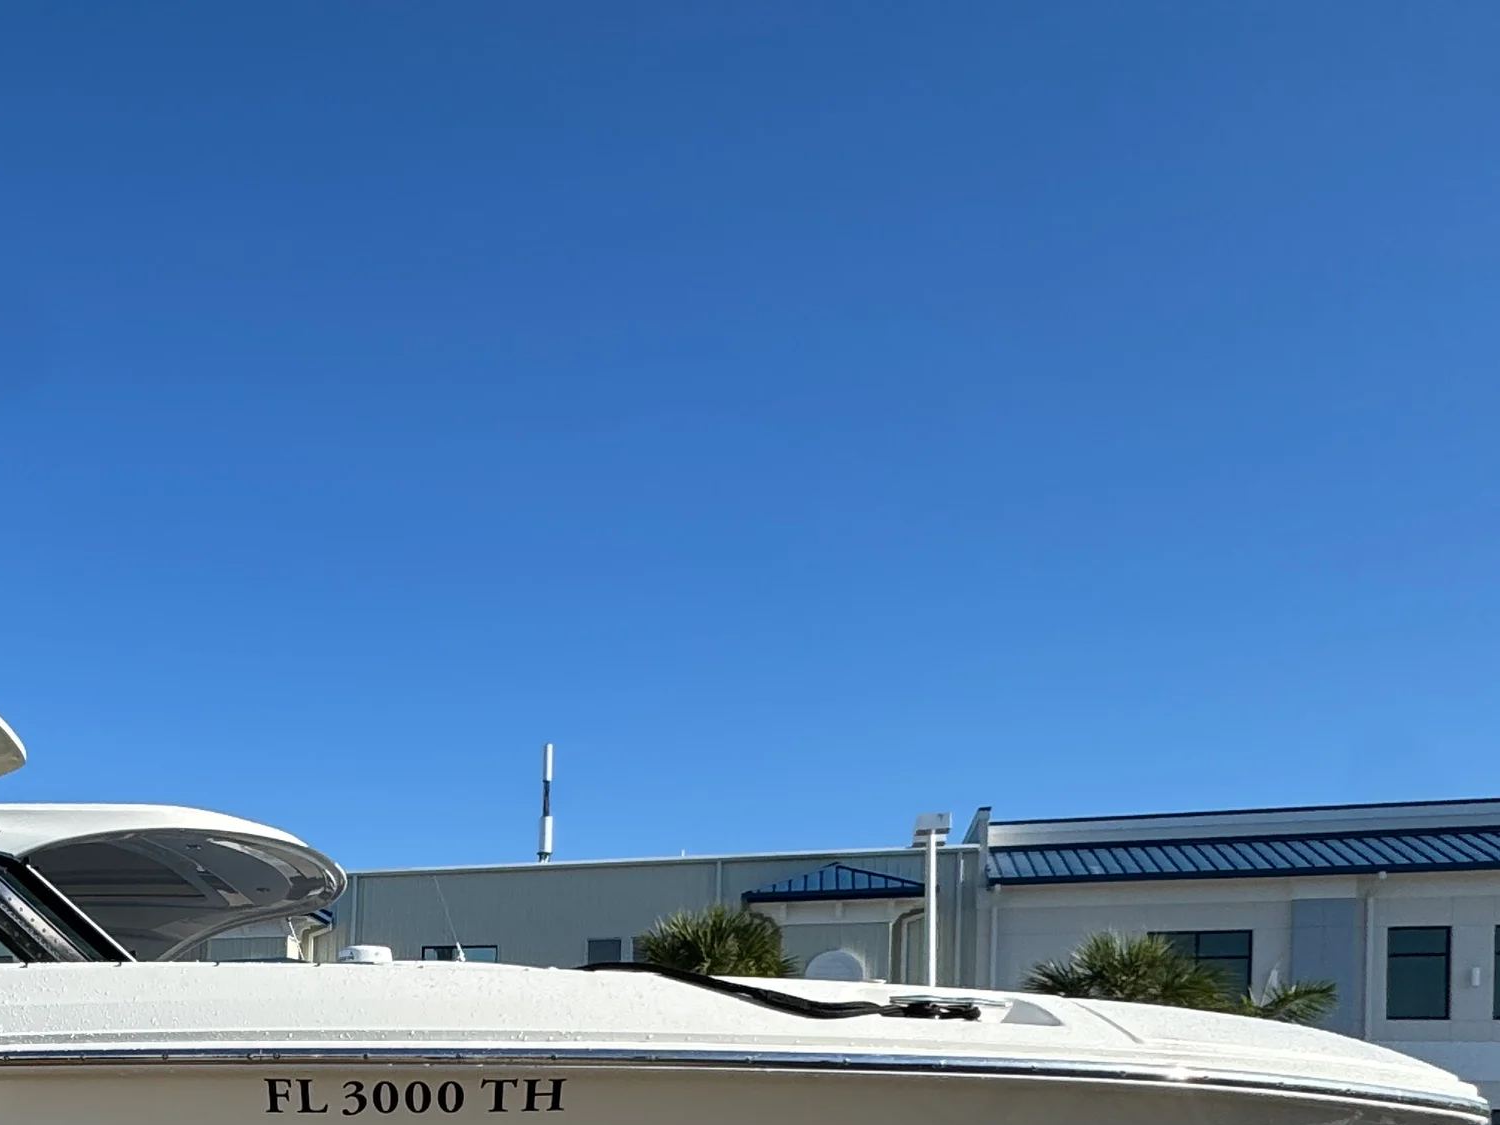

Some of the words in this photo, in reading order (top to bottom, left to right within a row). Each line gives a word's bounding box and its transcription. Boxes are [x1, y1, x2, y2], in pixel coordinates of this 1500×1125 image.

[263, 1077, 329, 1114] FL
[341, 1080, 465, 1116] 3000
[480, 1077, 567, 1113] TH
